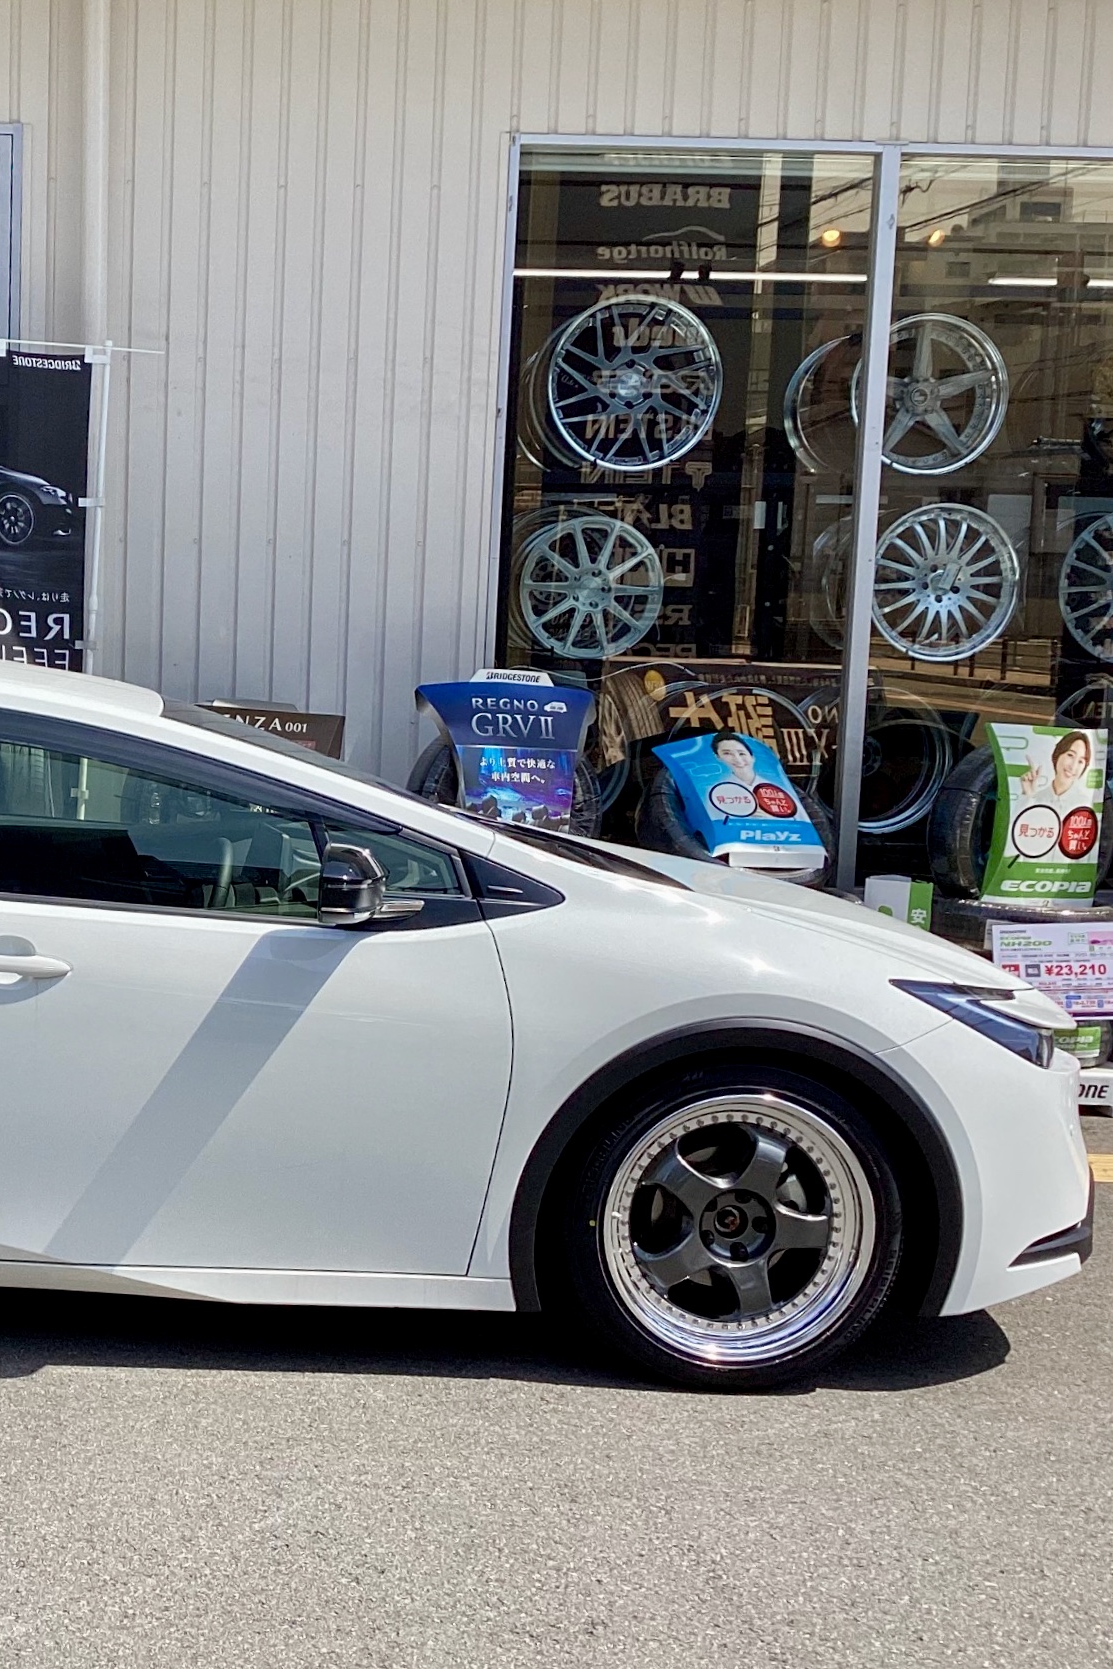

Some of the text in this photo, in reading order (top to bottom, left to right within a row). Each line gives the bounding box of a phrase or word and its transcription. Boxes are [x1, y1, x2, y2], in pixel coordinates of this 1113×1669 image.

[486, 671, 541, 683] BRIDGESTONE
[471, 697, 539, 712] REGNO
[284, 722, 308, 733] 001
[491, 773, 546, 784] 車内空間へ。
[716, 795, 752, 805] 見つかる
[740, 829, 802, 842] Playz
[1018, 823, 1055, 839] 見つかる
[1044, 963, 1108, 978] ¥23,210
